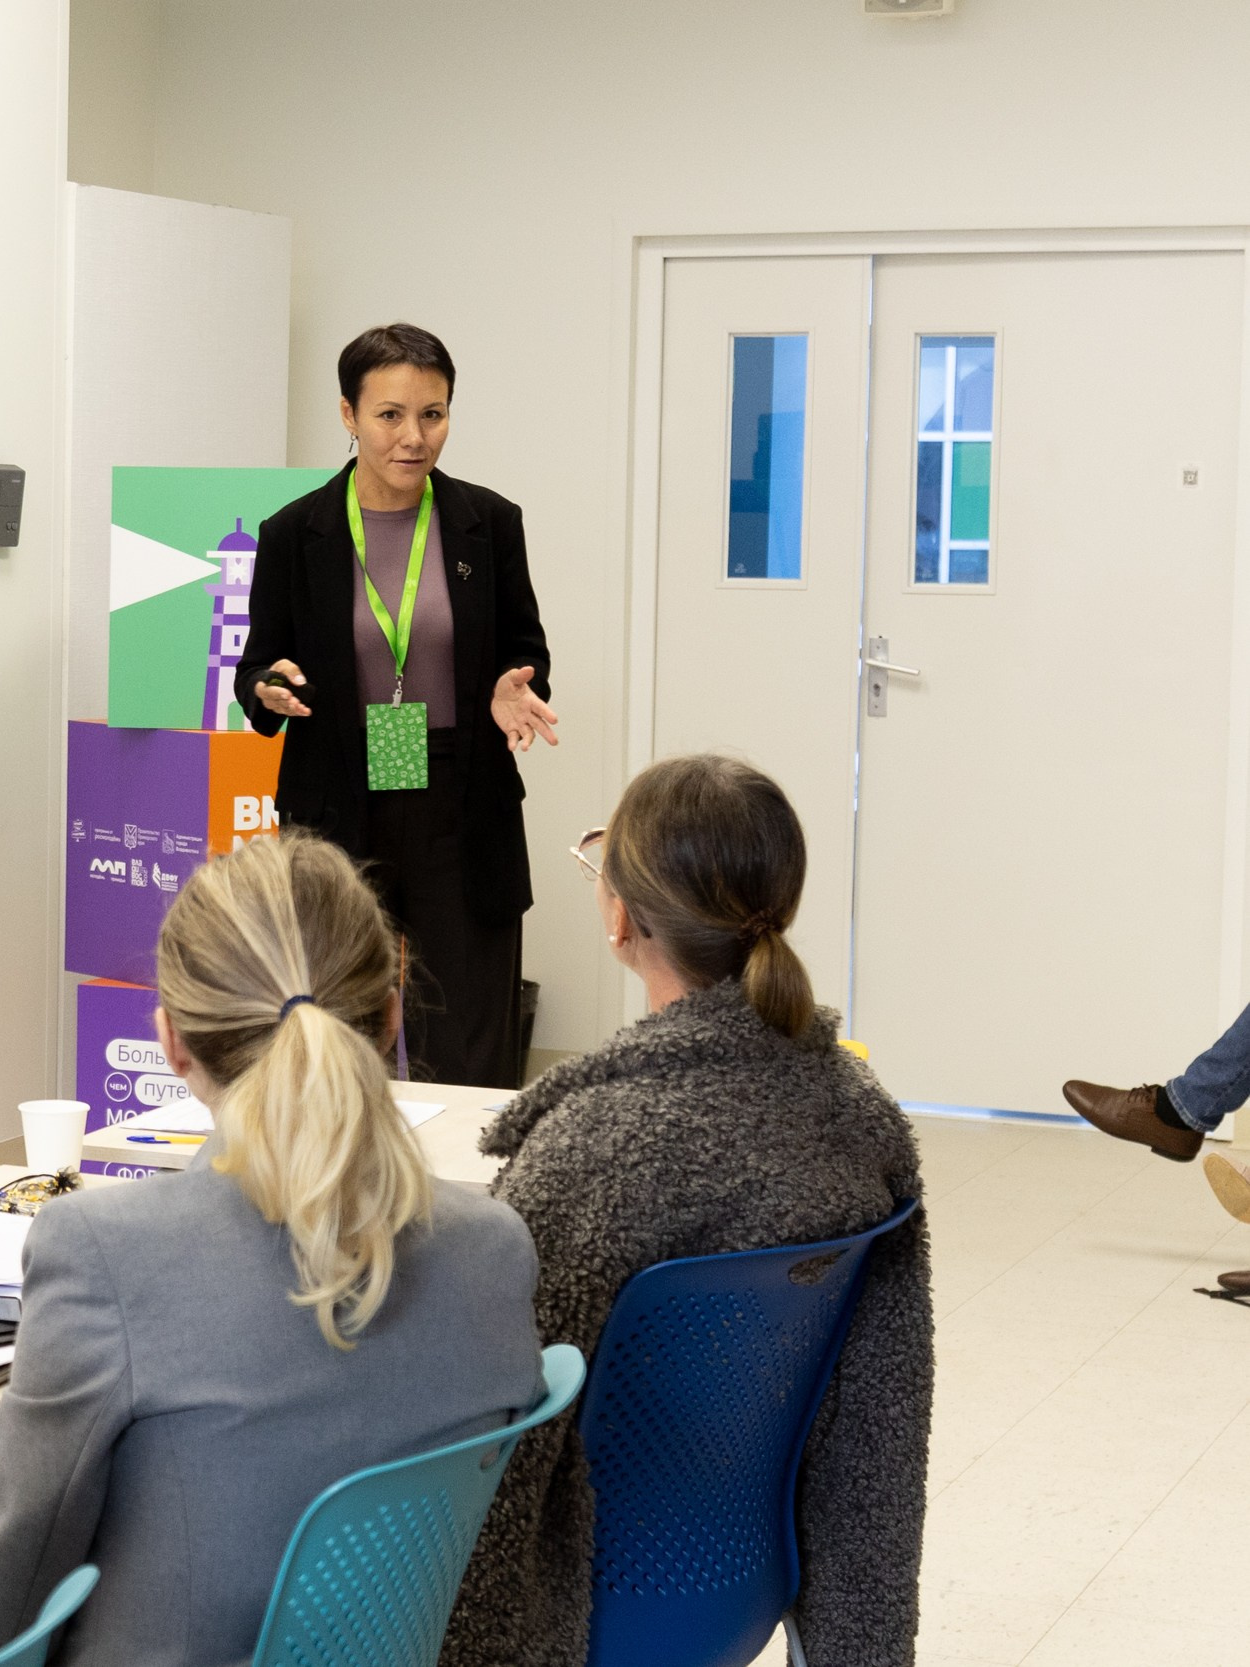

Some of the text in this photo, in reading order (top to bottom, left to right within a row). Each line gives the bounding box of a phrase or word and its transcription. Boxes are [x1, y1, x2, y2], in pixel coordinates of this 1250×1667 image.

[118, 1045, 171, 1065] Боль
[110, 1083, 128, 1092] ЧЕМ
[144, 1082, 191, 1102] путе
